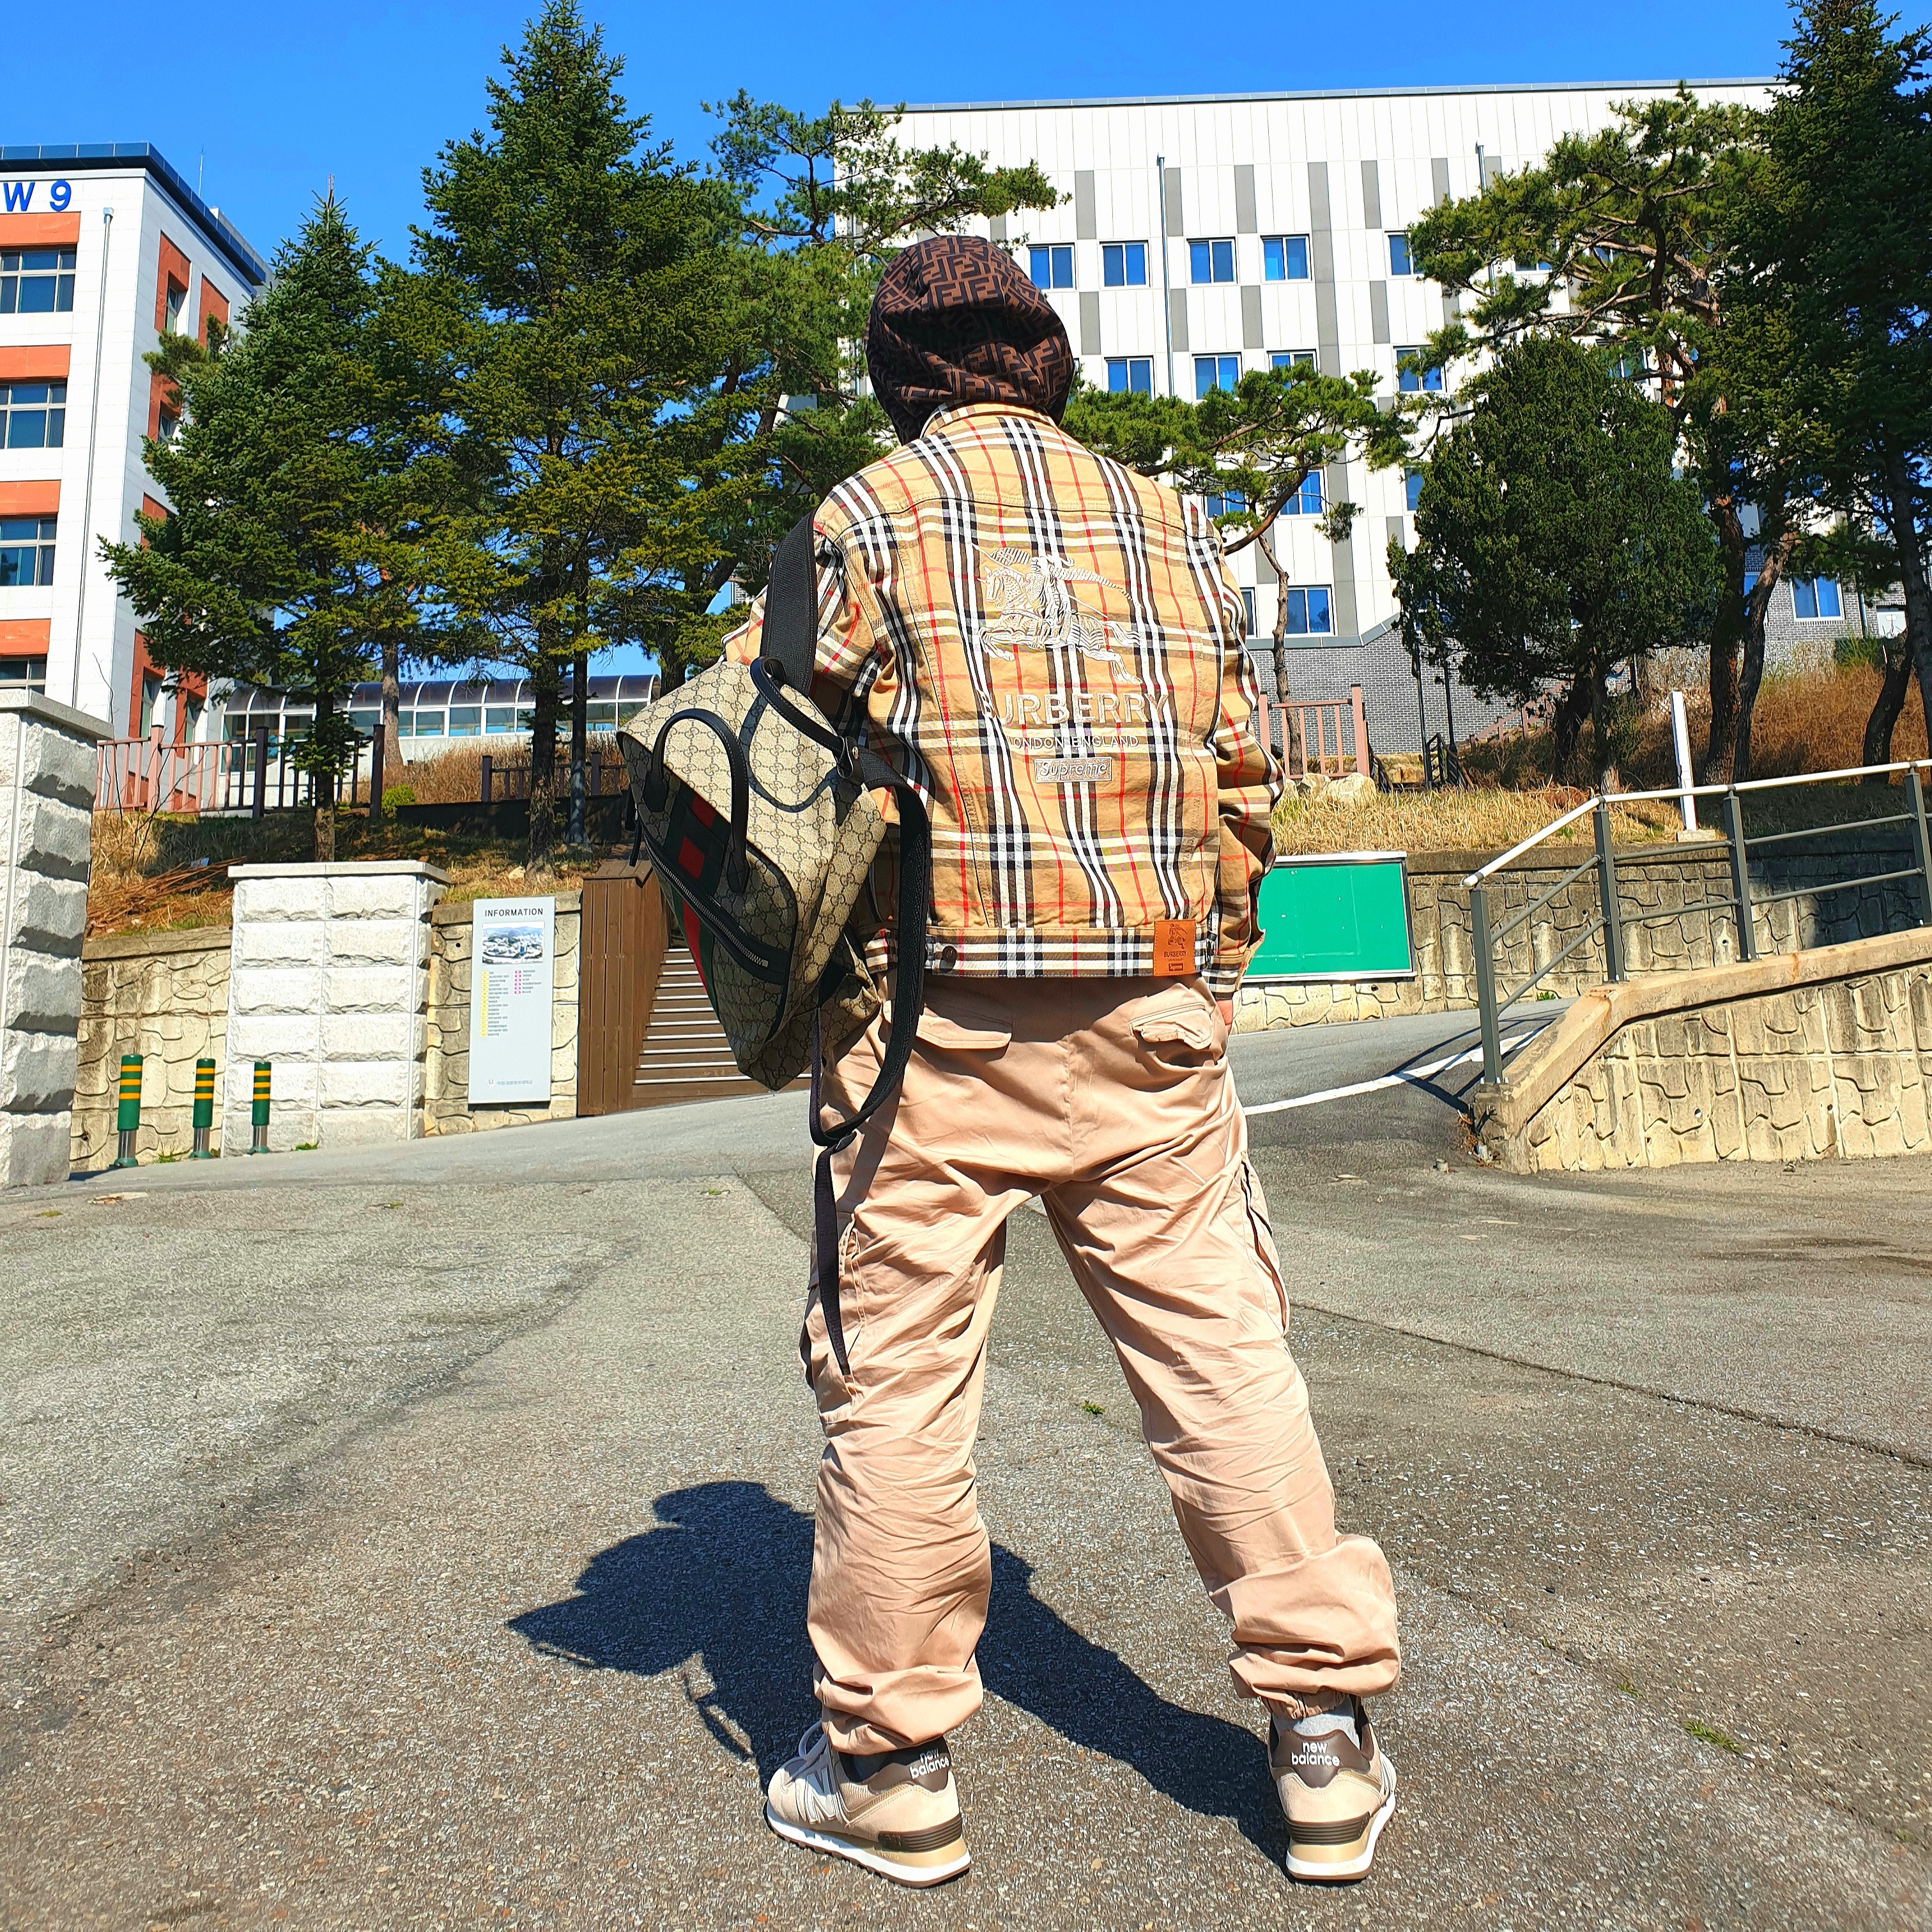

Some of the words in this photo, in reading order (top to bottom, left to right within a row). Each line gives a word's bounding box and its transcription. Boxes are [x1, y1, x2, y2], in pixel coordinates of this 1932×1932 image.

[1072, 735, 1138, 748] ENGLAND
[1040, 760, 1107, 781] Supreme
[485, 908, 543, 917] INFORMATION
[1303, 1742, 1328, 1753] new
[920, 1748, 939, 1763] new
[1291, 1752, 1340, 1767] balance
[909, 1756, 949, 1779] balance
